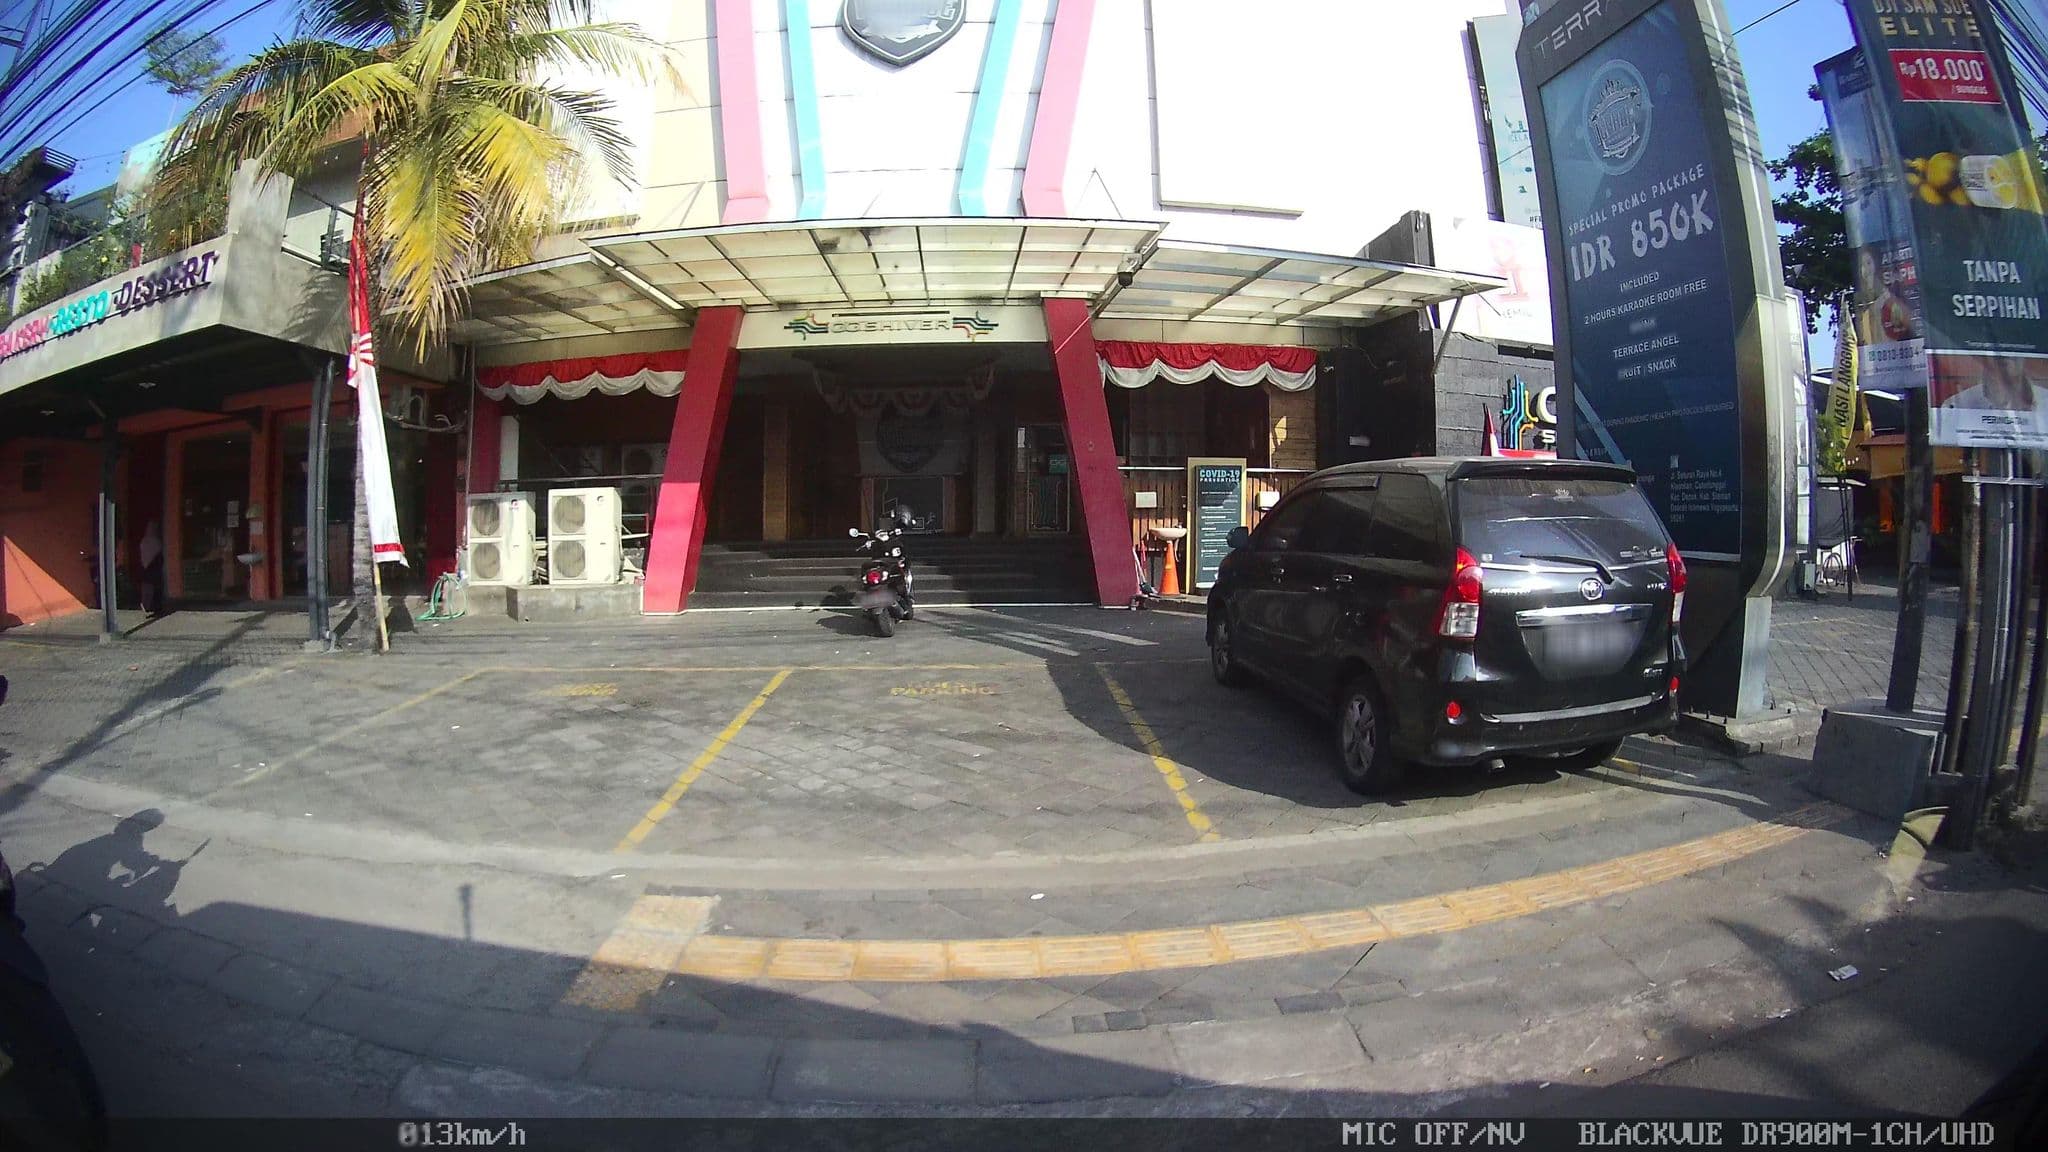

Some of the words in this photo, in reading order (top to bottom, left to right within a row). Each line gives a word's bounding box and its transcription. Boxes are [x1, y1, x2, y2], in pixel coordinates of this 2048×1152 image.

[1534, 0, 1609, 58] TERR
[1879, 16, 1981, 38] ELITE
[1568, 208, 1608, 236] SPECIAL
[1611, 191, 1647, 216] PROMO
[1651, 164, 1705, 198] PACKAGE
[1570, 235, 1616, 281] IDR
[1631, 189, 1713, 257] 850K
[1619, 271, 1660, 293] INCLUDED
[1963, 260, 2021, 284] TANPA
[1584, 315, 1590, 325] 2
[1590, 307, 1619, 323] HOURS
[1617, 295, 1656, 315] KARAOKE
[1657, 286, 1682, 303] ROOM
[1684, 279, 1708, 294] FREE
[1952, 294, 2041, 320] SERPIHAN
[1613, 342, 1650, 360] TERRACE
[1651, 335, 1680, 351] ANGEL
[1647, 358, 1677, 374] SNACK
[1834, 395, 1849, 428] NASI
[1199, 469, 1241, 478] COVID-19
